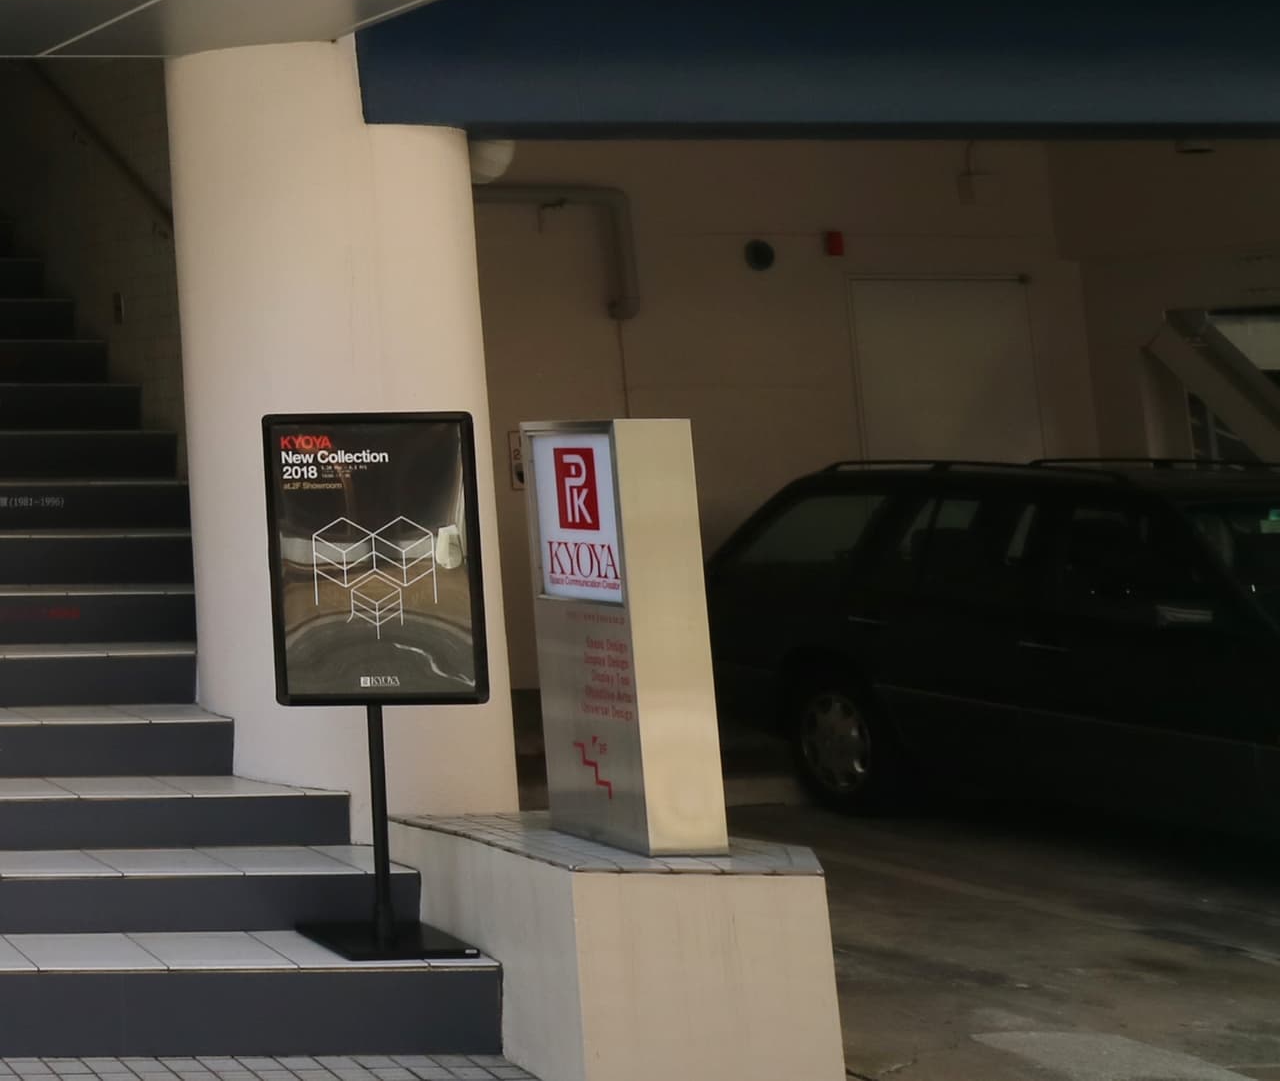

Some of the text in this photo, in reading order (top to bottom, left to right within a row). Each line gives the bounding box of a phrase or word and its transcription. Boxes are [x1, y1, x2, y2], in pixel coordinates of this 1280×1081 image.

[280, 434, 331, 449] KYOYA
[281, 450, 389, 464] New Collection
[282, 466, 317, 479] 2018
[303, 482, 342, 490] Showroom
[548, 541, 620, 579] KYOYA
